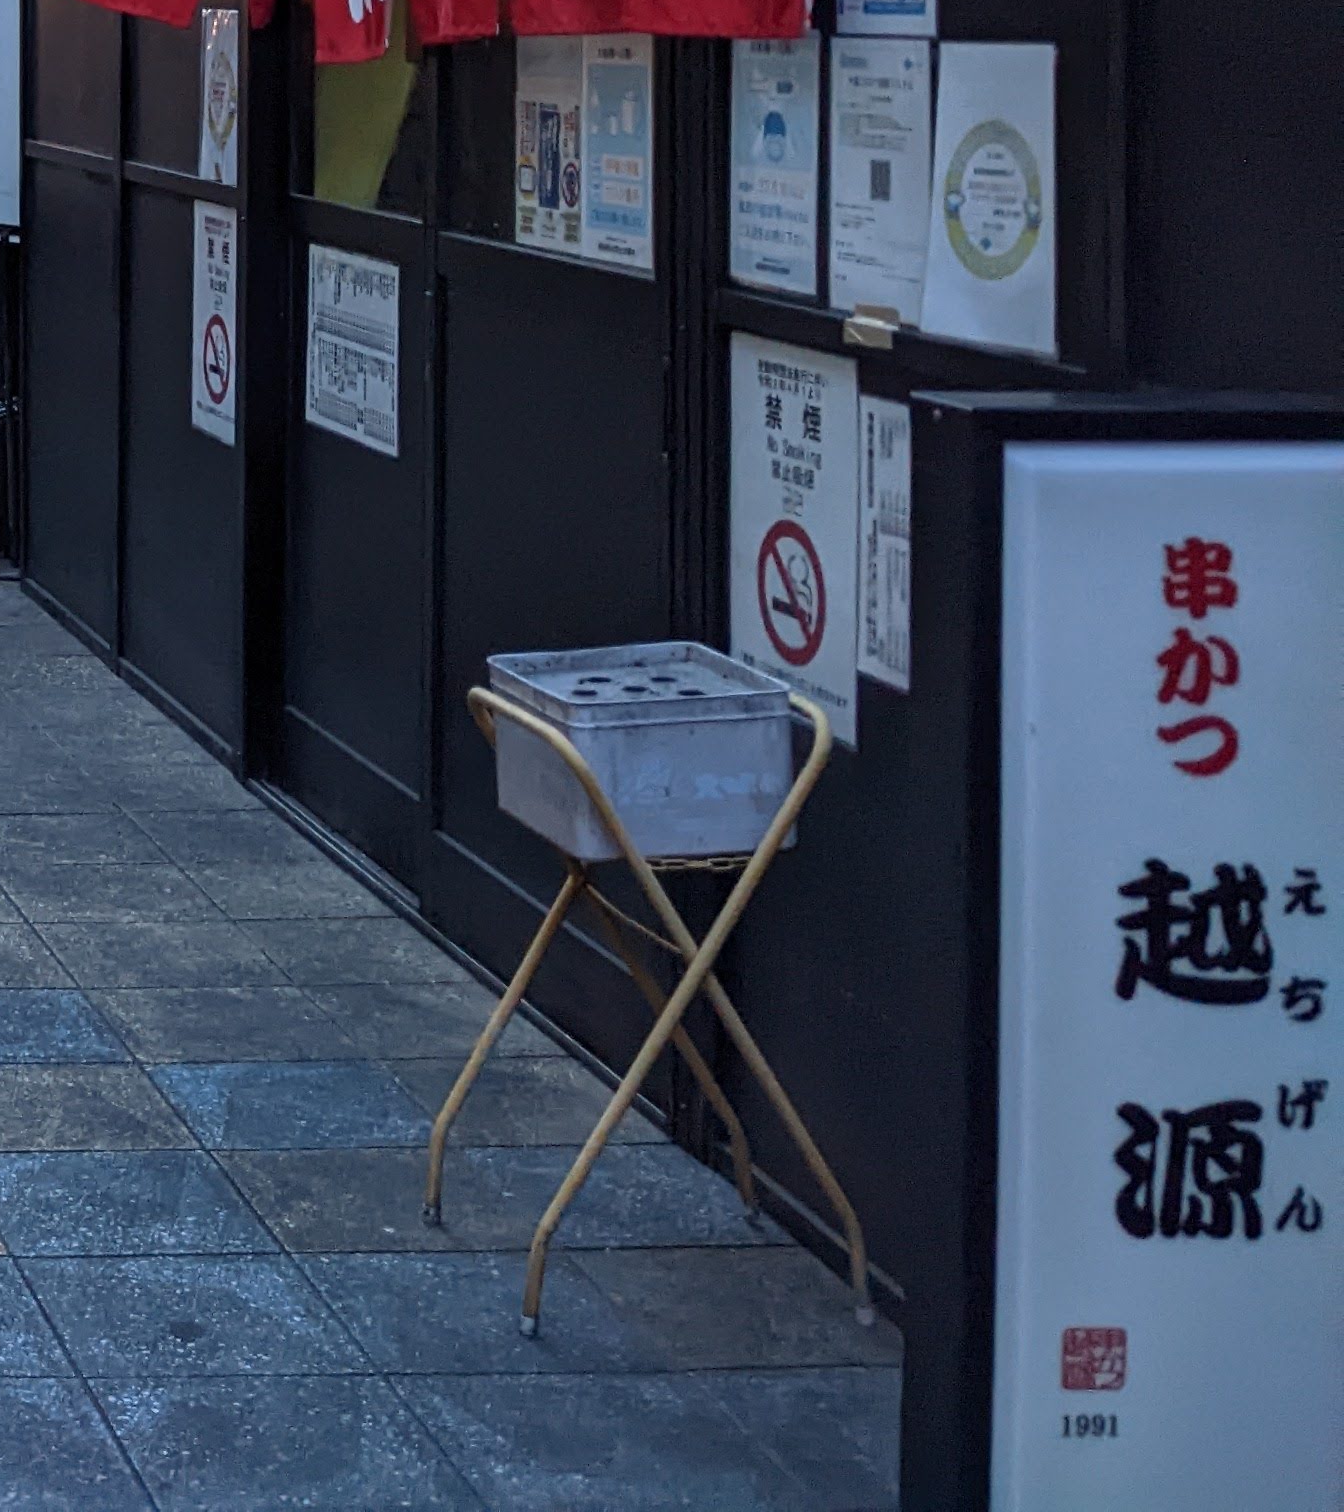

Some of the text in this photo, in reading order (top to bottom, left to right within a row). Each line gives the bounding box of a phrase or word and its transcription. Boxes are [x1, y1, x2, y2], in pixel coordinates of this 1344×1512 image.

[1156, 535, 1240, 778] 串かつ
[1114, 858, 1274, 1241] 越源
[1275, 866, 1329, 1234] えちげん
[1061, 1415, 1119, 1438] 1991
